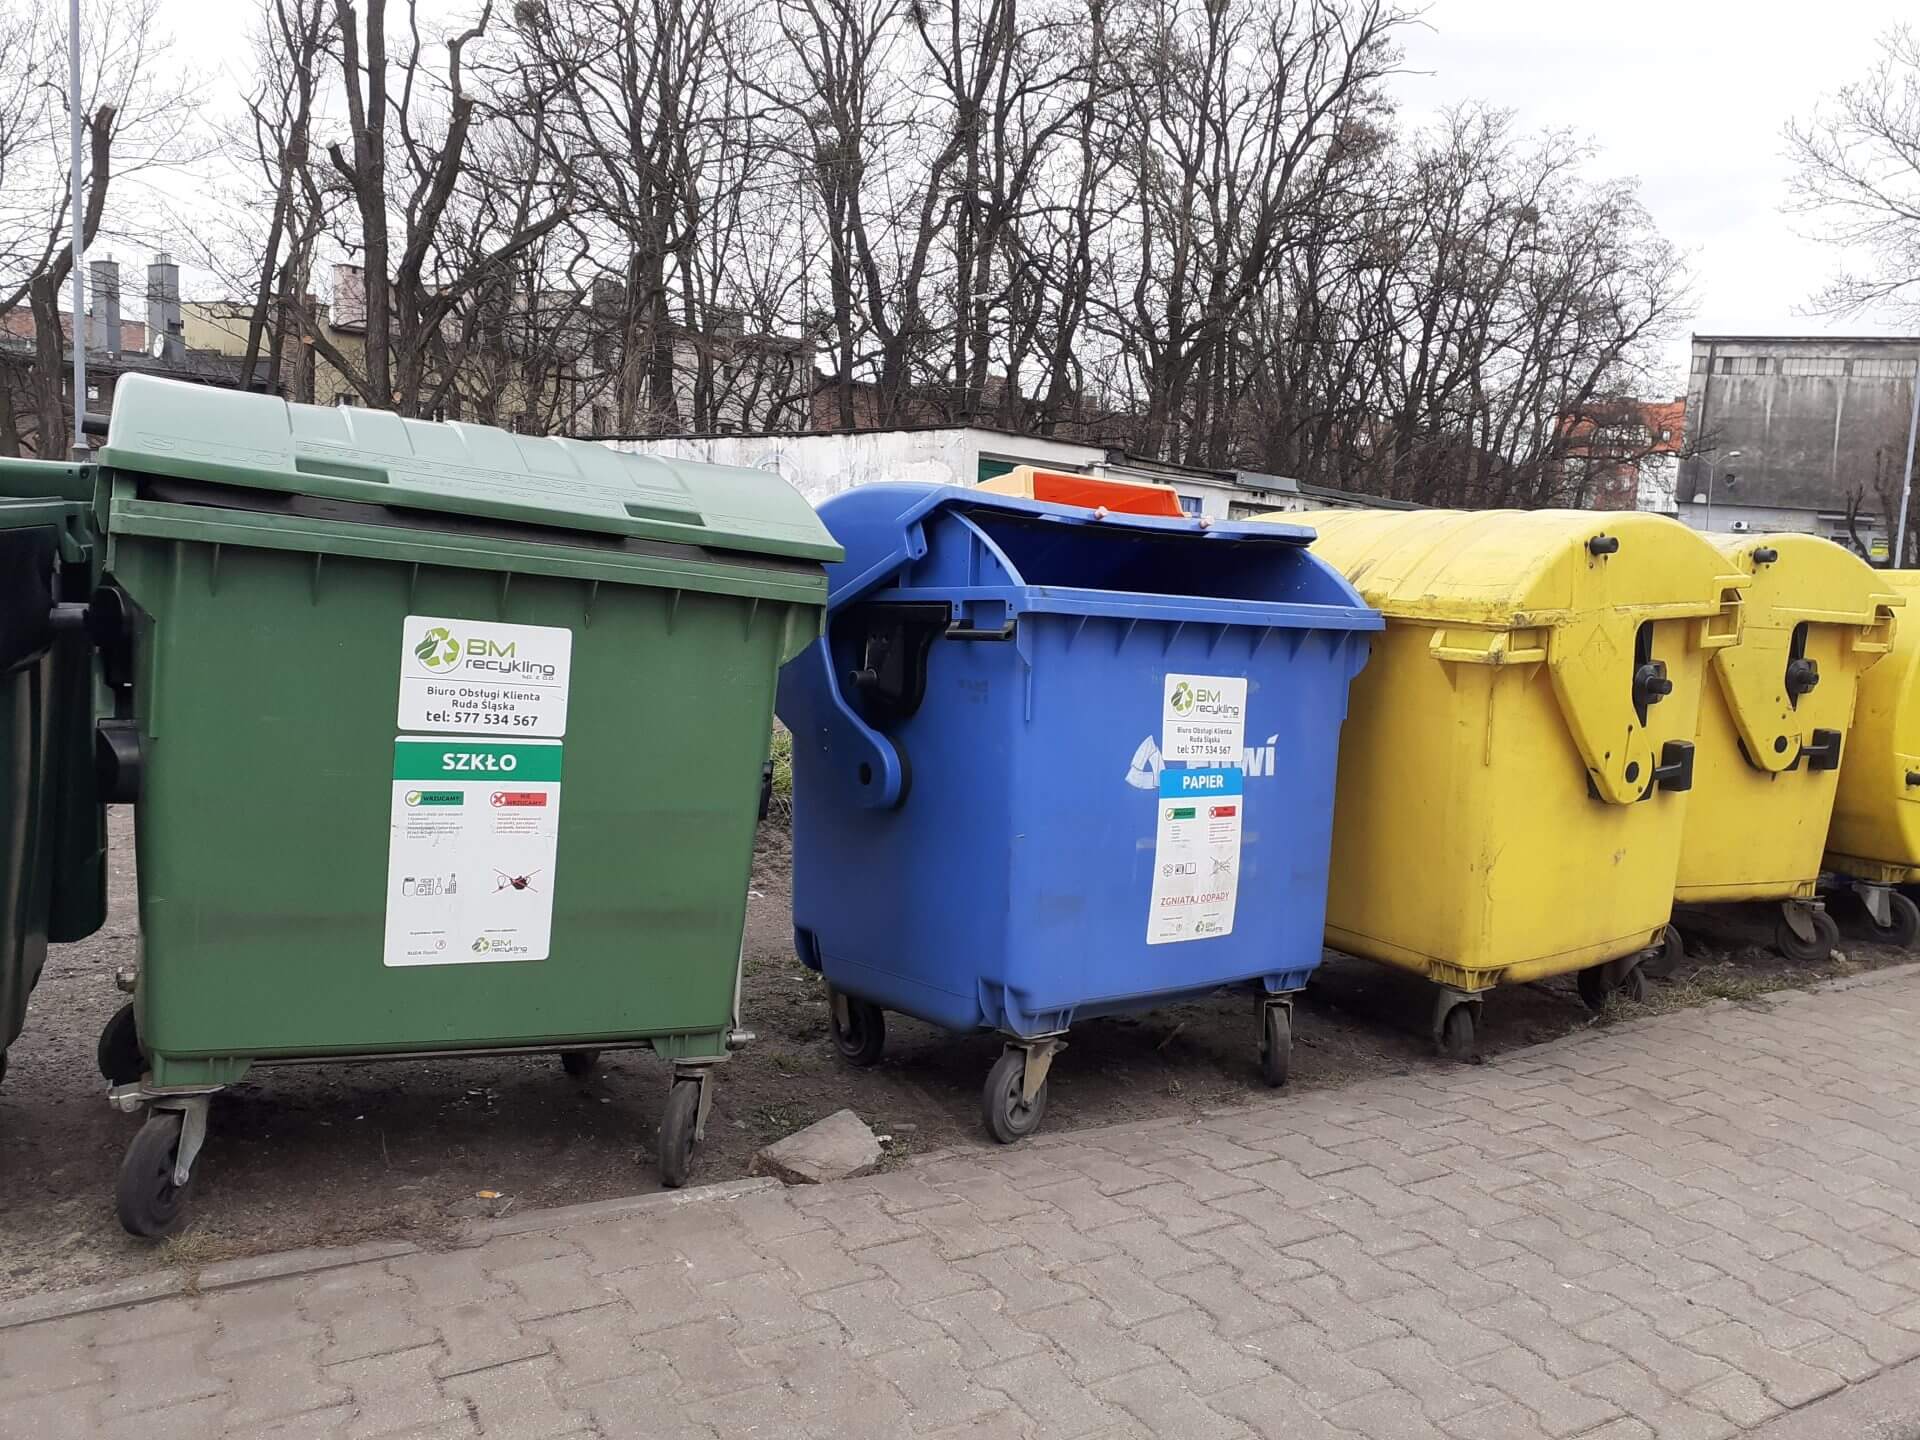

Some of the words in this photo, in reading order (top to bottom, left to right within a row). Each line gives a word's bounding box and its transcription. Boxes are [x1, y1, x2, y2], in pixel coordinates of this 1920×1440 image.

[467, 638, 516, 658] BM
[465, 659, 556, 677] recykling
[427, 686, 456, 697] Biuro
[459, 688, 500, 701] Obsługi
[503, 690, 541, 701] Klienta
[1196, 689, 1221, 703] BM
[452, 699, 479, 710] Ruda
[481, 699, 515, 712] Śląska
[1195, 704, 1240, 716] recykling
[426, 710, 451, 723] tel:
[454, 712, 480, 724] 577
[483, 713, 509, 726] 534
[513, 715, 538, 727] 567
[1176, 726, 1192, 735] Biuro
[1176, 745, 1189, 754] tel:
[1191, 745, 1204, 754] 577
[1205, 746, 1218, 755] 534
[1219, 746, 1232, 755] 567
[442, 753, 517, 771] SZKŁO
[1182, 774, 1224, 790] PAPIER
[1160, 895, 1200, 906] ZGNIATAJ
[1201, 891, 1230, 903] ODPADY
